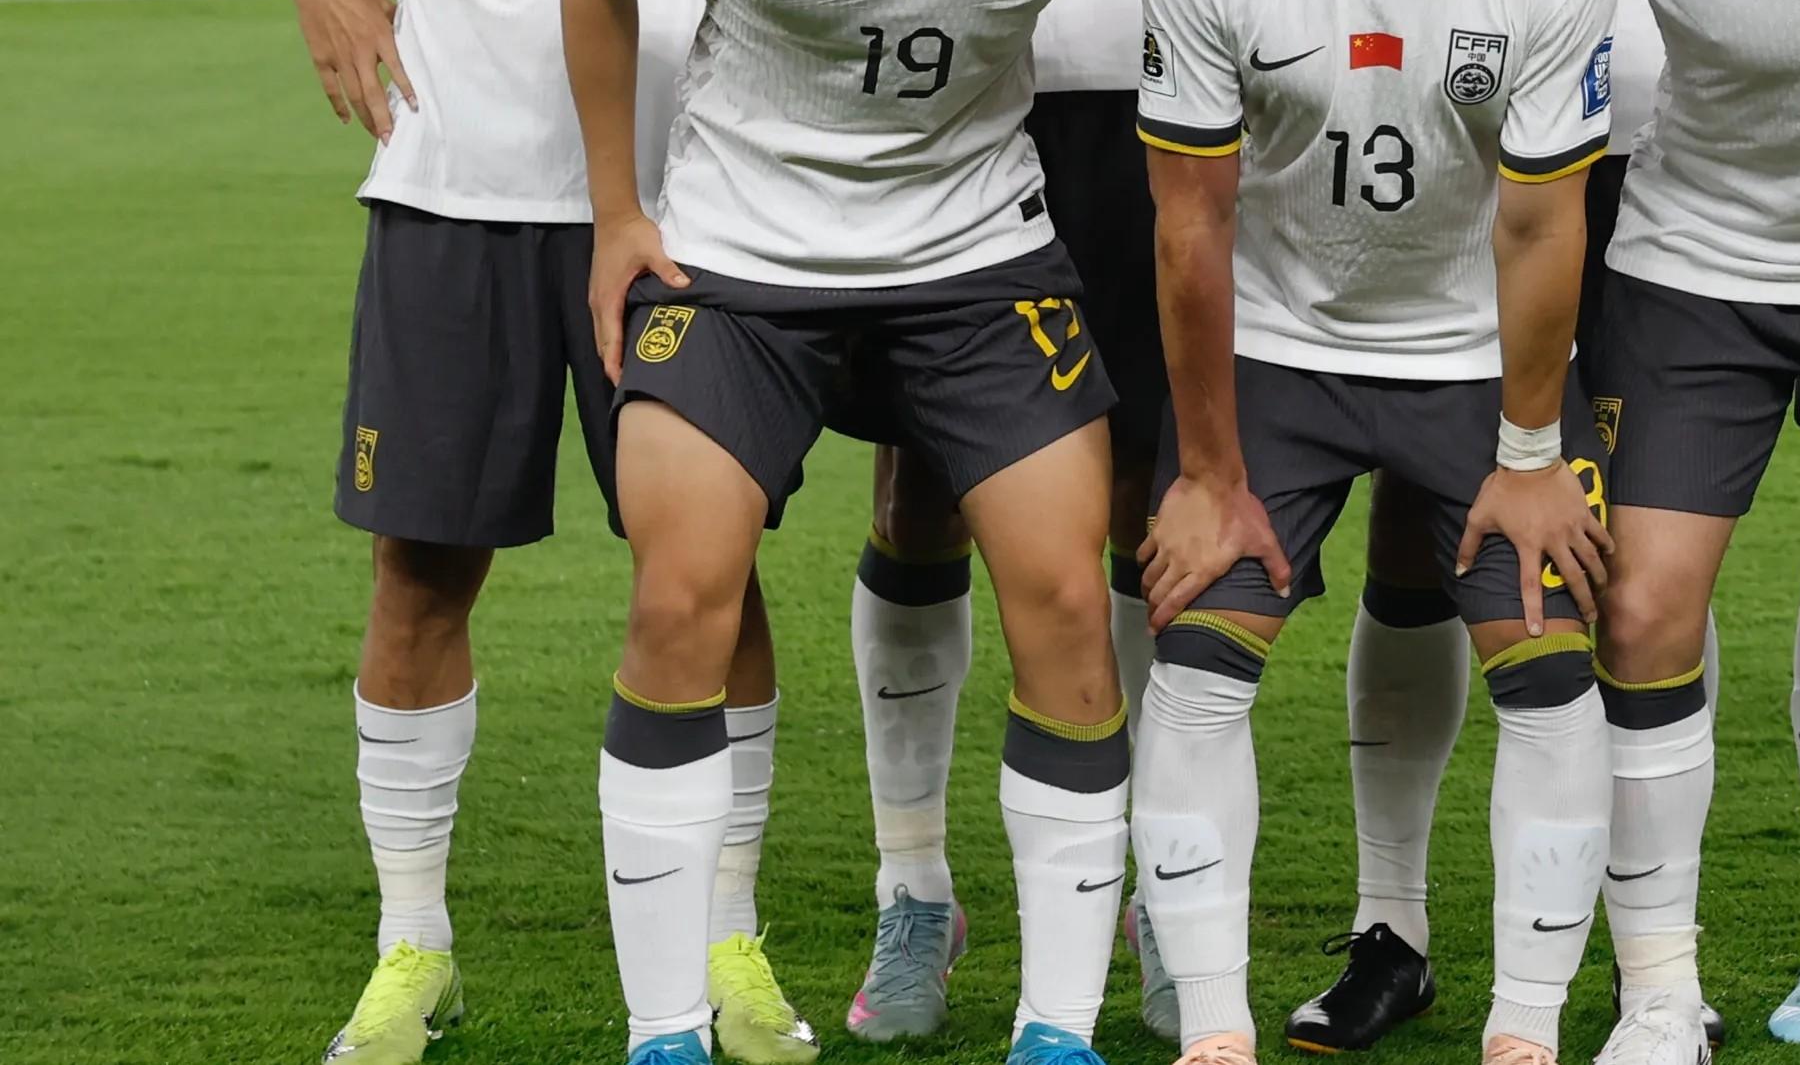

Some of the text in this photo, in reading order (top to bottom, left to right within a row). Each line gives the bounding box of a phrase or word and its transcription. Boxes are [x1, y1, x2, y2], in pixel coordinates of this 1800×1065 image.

[860, 25, 954, 98] 19
[1455, 35, 1502, 54] CFA
[1326, 124, 1415, 212] 13
[654, 307, 690, 322] CFA
